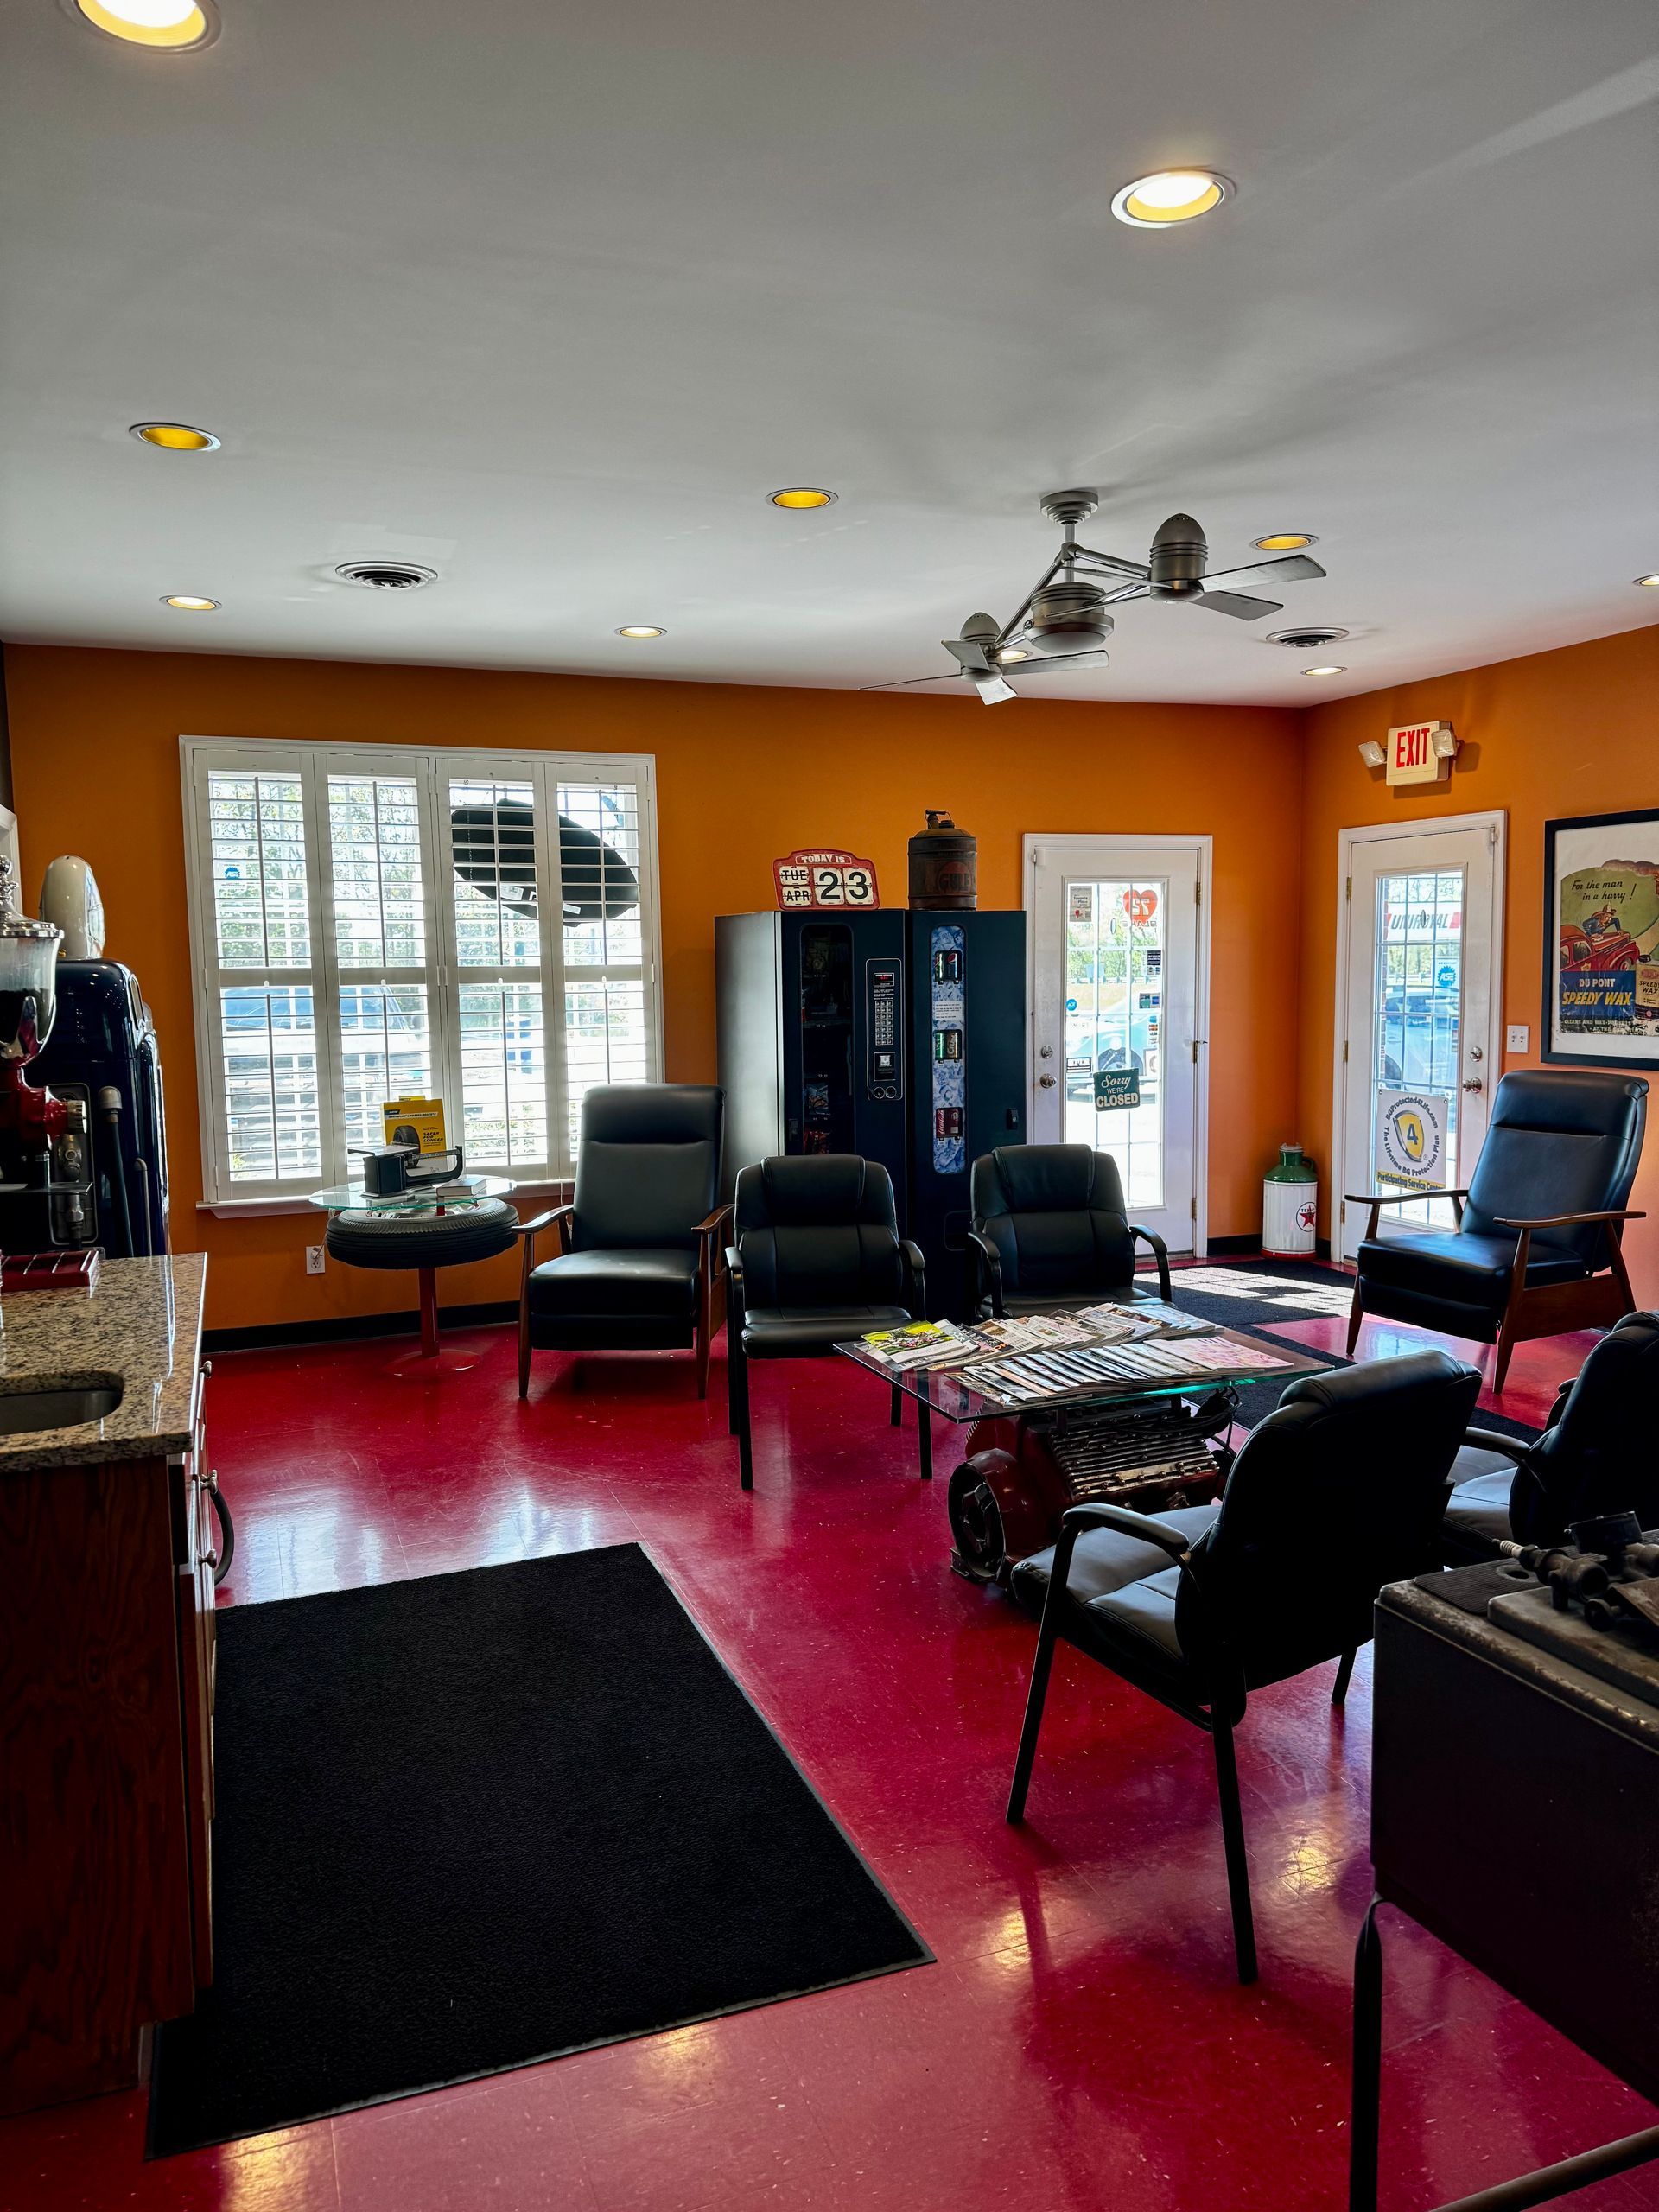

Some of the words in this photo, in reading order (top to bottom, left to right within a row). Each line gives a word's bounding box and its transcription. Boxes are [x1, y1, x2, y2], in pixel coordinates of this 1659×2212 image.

[1396, 728, 1430, 768] EXIT
[782, 869, 807, 880] TUE
[1572, 880, 1583, 890] For
[1586, 880, 1600, 889] the
[786, 890, 810, 901] APR
[1601, 891, 1625, 904] hurry
[1440, 972, 1454, 981] ASE
[1579, 978, 1590, 987] DU
[1592, 978, 1616, 987] PONT
[1562, 992, 1603, 1005] SPEEDY
[1605, 992, 1632, 1005] WAX
[1101, 1074, 1131, 1090] Sorry
[1096, 1092, 1139, 1108] CLOSED
[1407, 1123, 1419, 1145] 4
[1385, 1142, 1402, 1171] Lifetime
[1402, 1166, 1411, 1176] BG
[1412, 1154, 1438, 1176] Protection
[1377, 1171, 1408, 1188] Participating
[1408, 1179, 1426, 1191] Service
[1426, 1182, 1446, 1191] Cent
